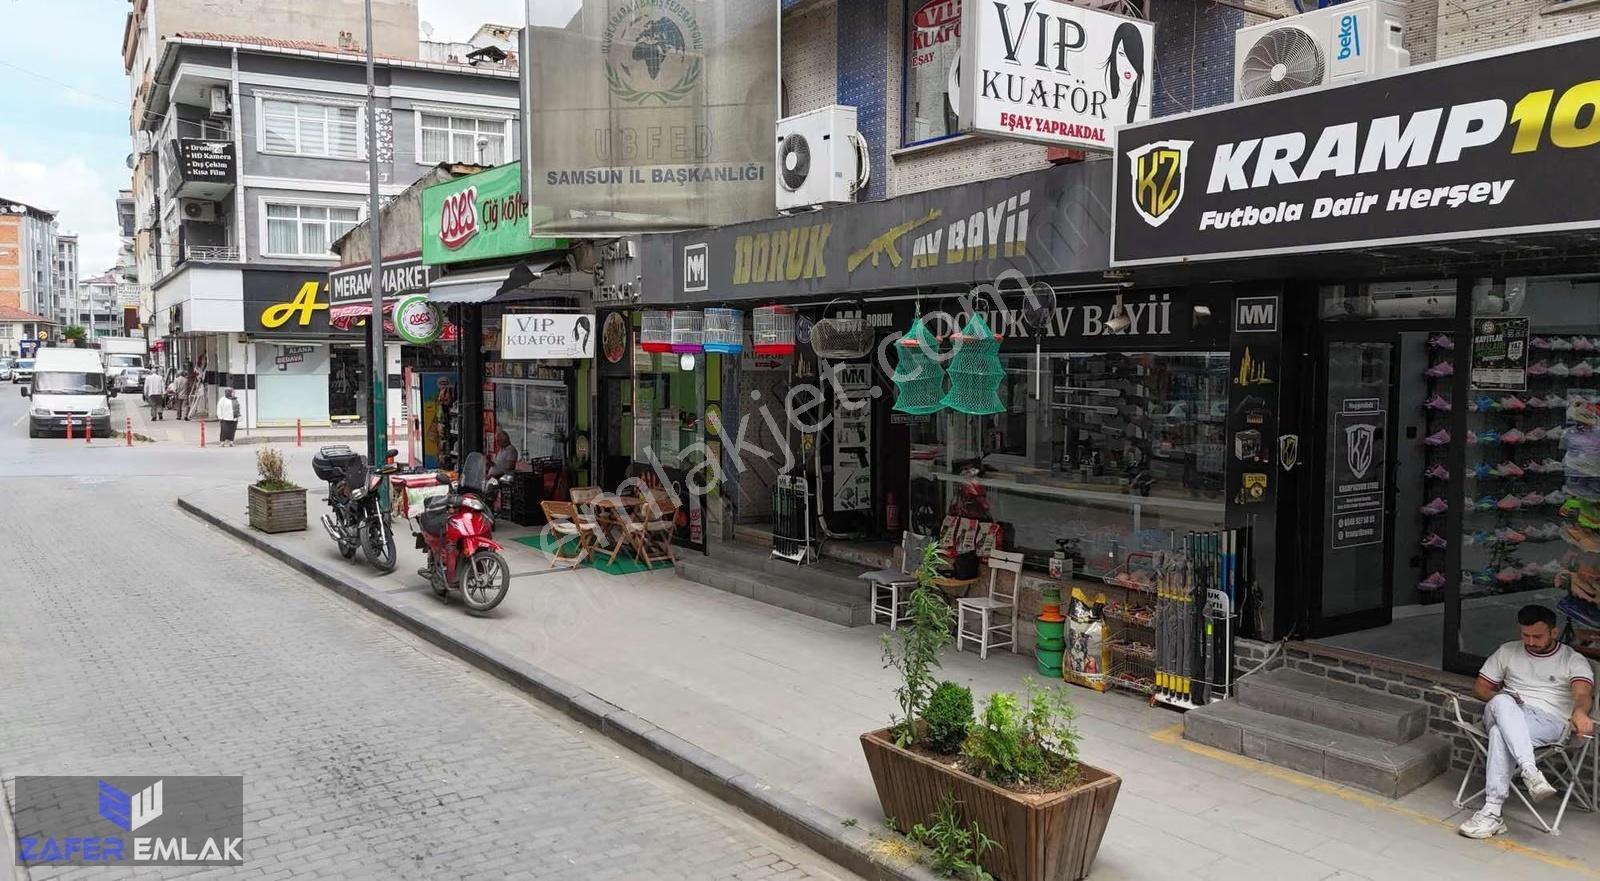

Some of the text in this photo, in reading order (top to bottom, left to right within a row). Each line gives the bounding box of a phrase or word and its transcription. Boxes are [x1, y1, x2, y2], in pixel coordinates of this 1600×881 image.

[993, 0, 1087, 72] VIP
[1337, 15, 1352, 60] beko
[981, 69, 1108, 119] KUAFÖR
[595, 125, 714, 161] UBFED
[1000, 112, 1105, 142] EŞAY YAPRAKDAL
[547, 163, 764, 186] SAMSUN İL BAŞKANLIĞI
[1138, 150, 1180, 218] KZ
[482, 198, 498, 231] Çiğ
[501, 191, 528, 226] köfte
[1199, 178, 1515, 231] Futbola Dair Herşey
[733, 224, 832, 284] DORUK
[911, 228, 943, 269] AV
[334, 265, 431, 297] MERAM MARKET
[410, 312, 430, 325] oses
[516, 316, 554, 332] VIP
[866, 313, 893, 327] DORUK
[1240, 305, 1273, 325] MM
[289, 346, 313, 354] ALANA
[507, 334, 565, 346] KUAFÖR
